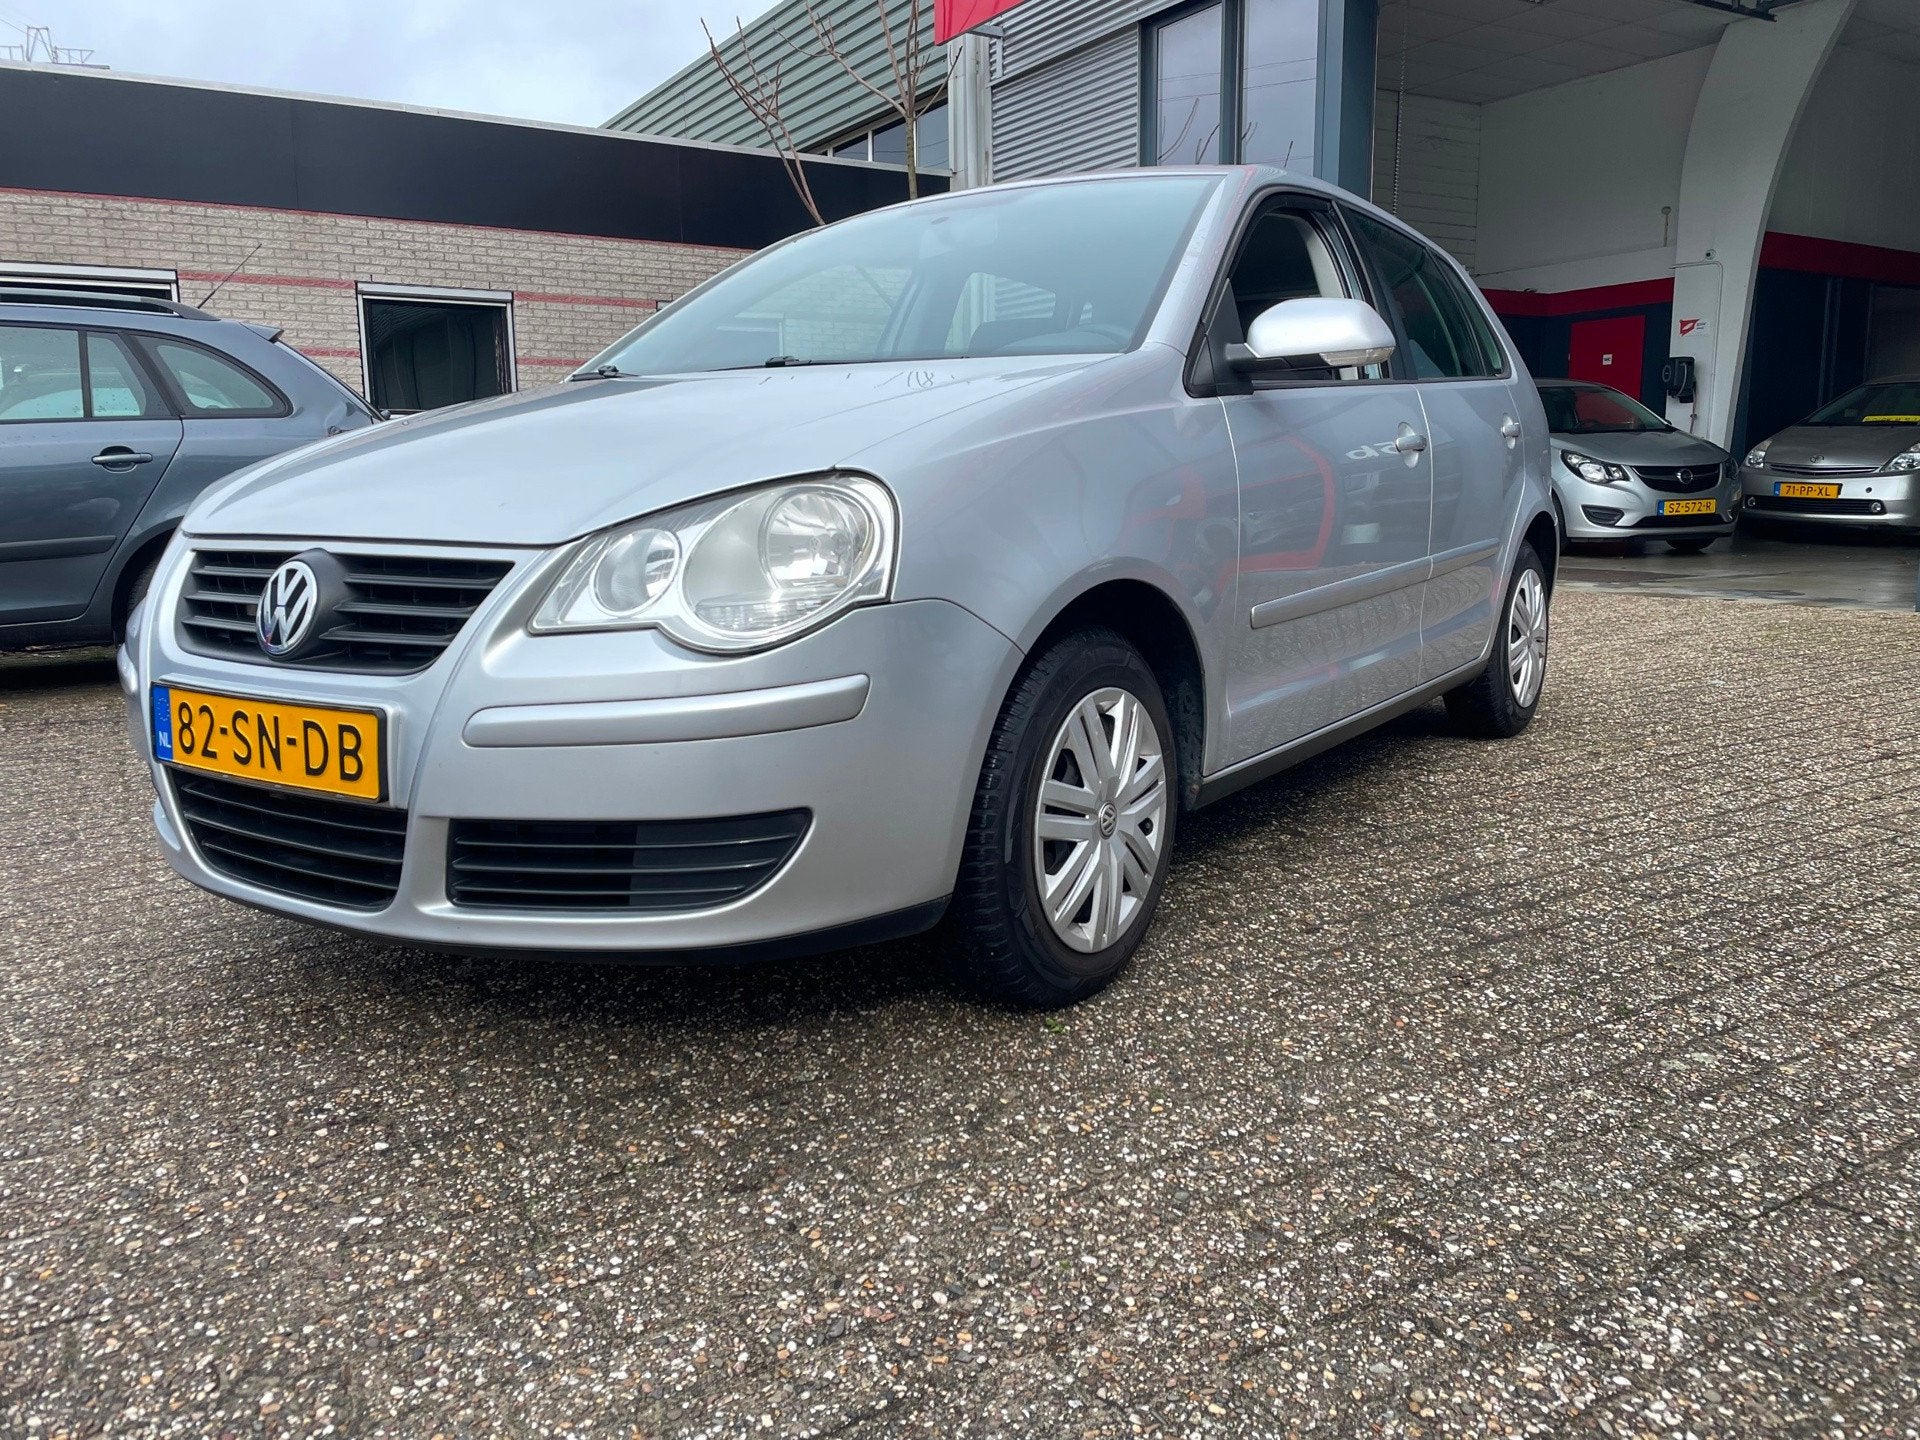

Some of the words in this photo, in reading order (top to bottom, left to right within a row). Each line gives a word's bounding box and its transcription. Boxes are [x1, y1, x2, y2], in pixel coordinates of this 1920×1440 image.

[1786, 485, 1830, 496] 71-PP-XL
[1668, 501, 1712, 513] SZ-572-R
[158, 730, 172, 749] NL
[177, 701, 363, 782] 82-SN-DB
